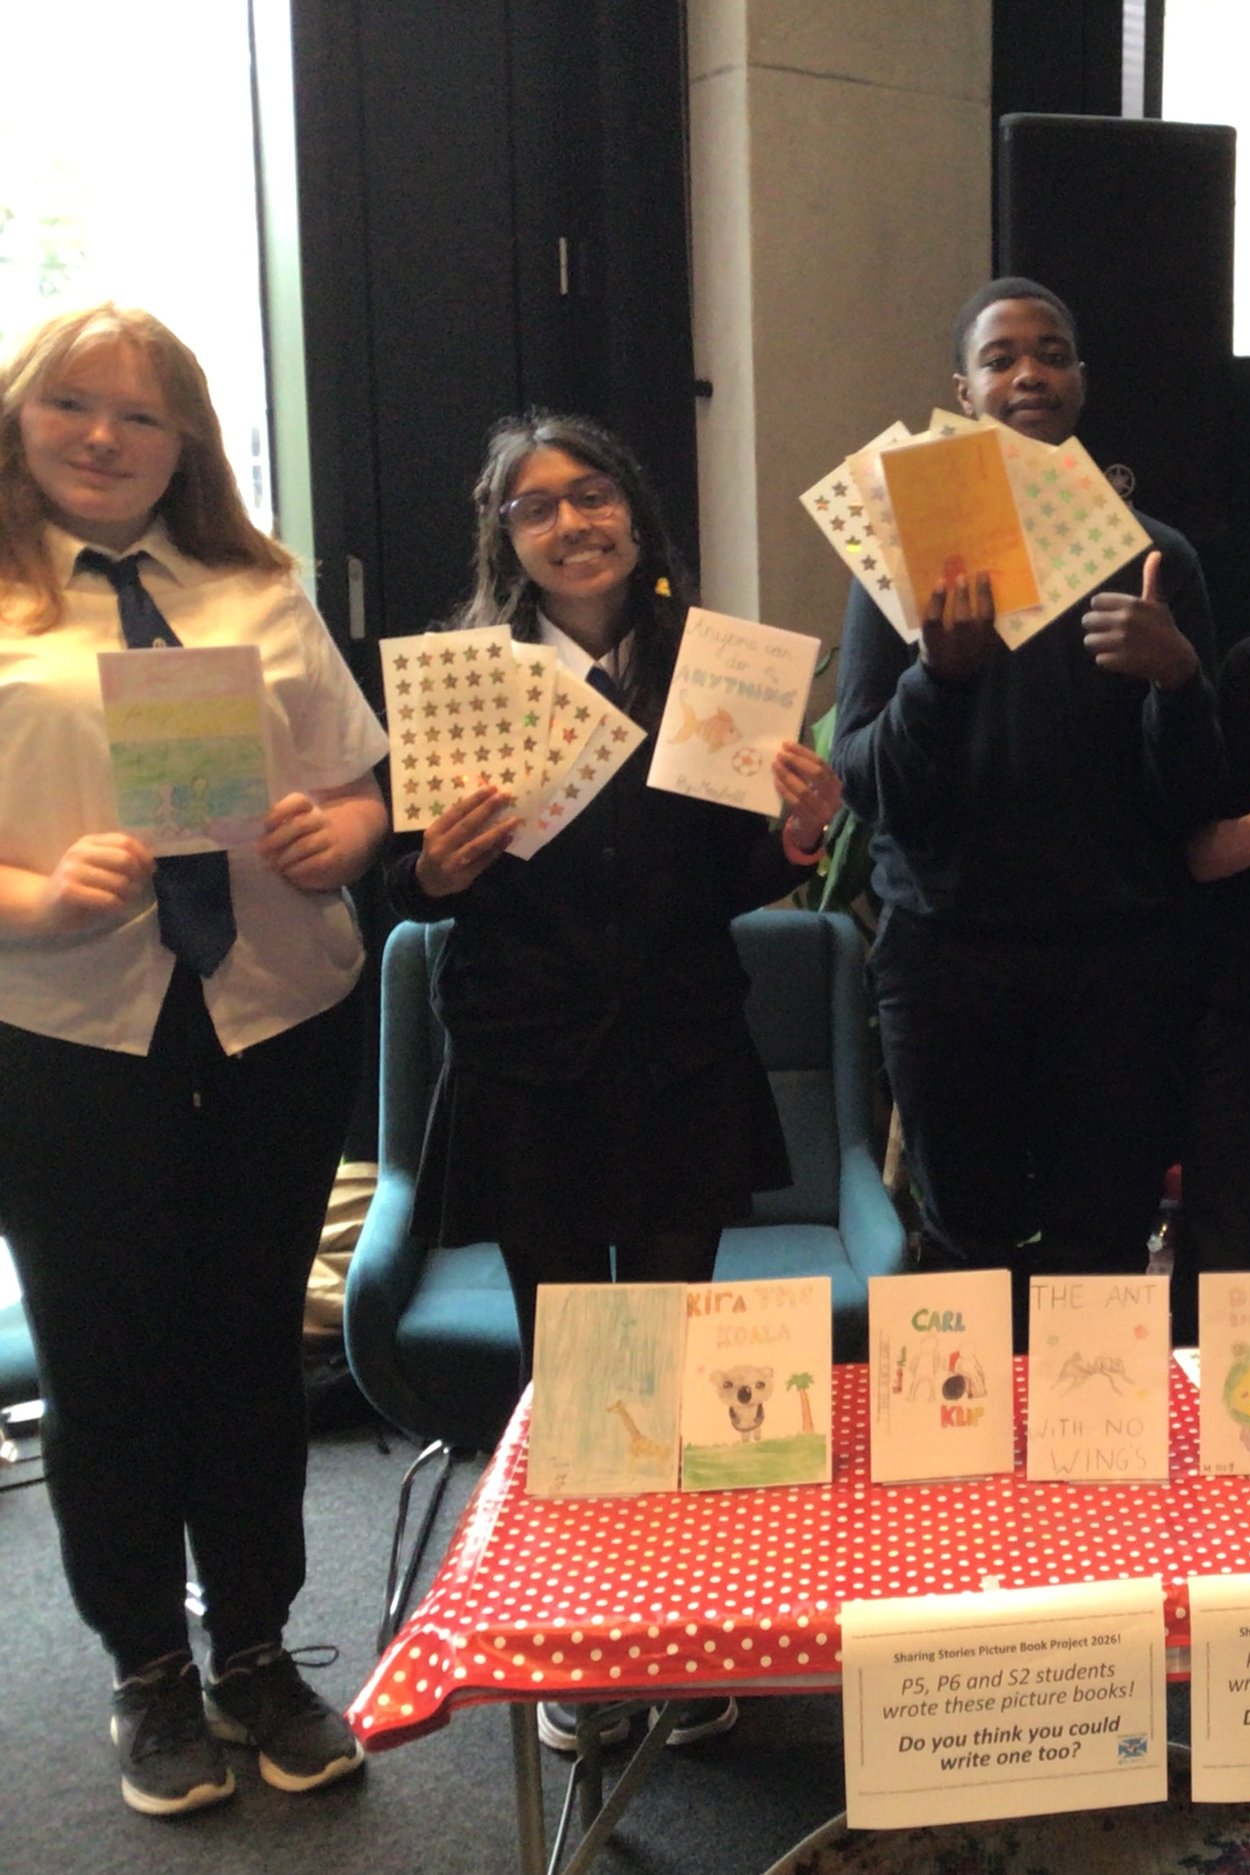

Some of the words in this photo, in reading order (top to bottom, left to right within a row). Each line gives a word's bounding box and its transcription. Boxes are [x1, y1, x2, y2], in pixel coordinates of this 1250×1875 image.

[1030, 1284, 1084, 1310] THE
[1104, 1284, 1156, 1309] ANT
[912, 1308, 965, 1332] CARL
[1105, 1417, 1144, 1439] NO
[894, 1652, 935, 1663] Sharing
[938, 1648, 975, 1660] Stories
[979, 1645, 1016, 1656] Picture
[1020, 1640, 1046, 1652] Book
[1051, 1637, 1088, 1651] Project
[1091, 1634, 1121, 1645] 2026!
[902, 1677, 929, 1696] P5,
[937, 1675, 960, 1692] P6
[967, 1670, 1002, 1688] and
[1008, 1668, 1030, 1686] S2
[1036, 1662, 1115, 1684] students
[883, 1700, 937, 1719] wrote
[945, 1696, 995, 1715] these
[1001, 1689, 1067, 1712] picture
[1073, 1681, 1134, 1703] books!
[899, 1737, 925, 1752] Do
[932, 1735, 966, 1753] you
[973, 1726, 1022, 1746] think
[1029, 1728, 1062, 1743] you
[1069, 1716, 1120, 1736] could
[940, 1747, 990, 1770] write
[997, 1749, 1031, 1766] one
[1038, 1742, 1082, 1762] too?
